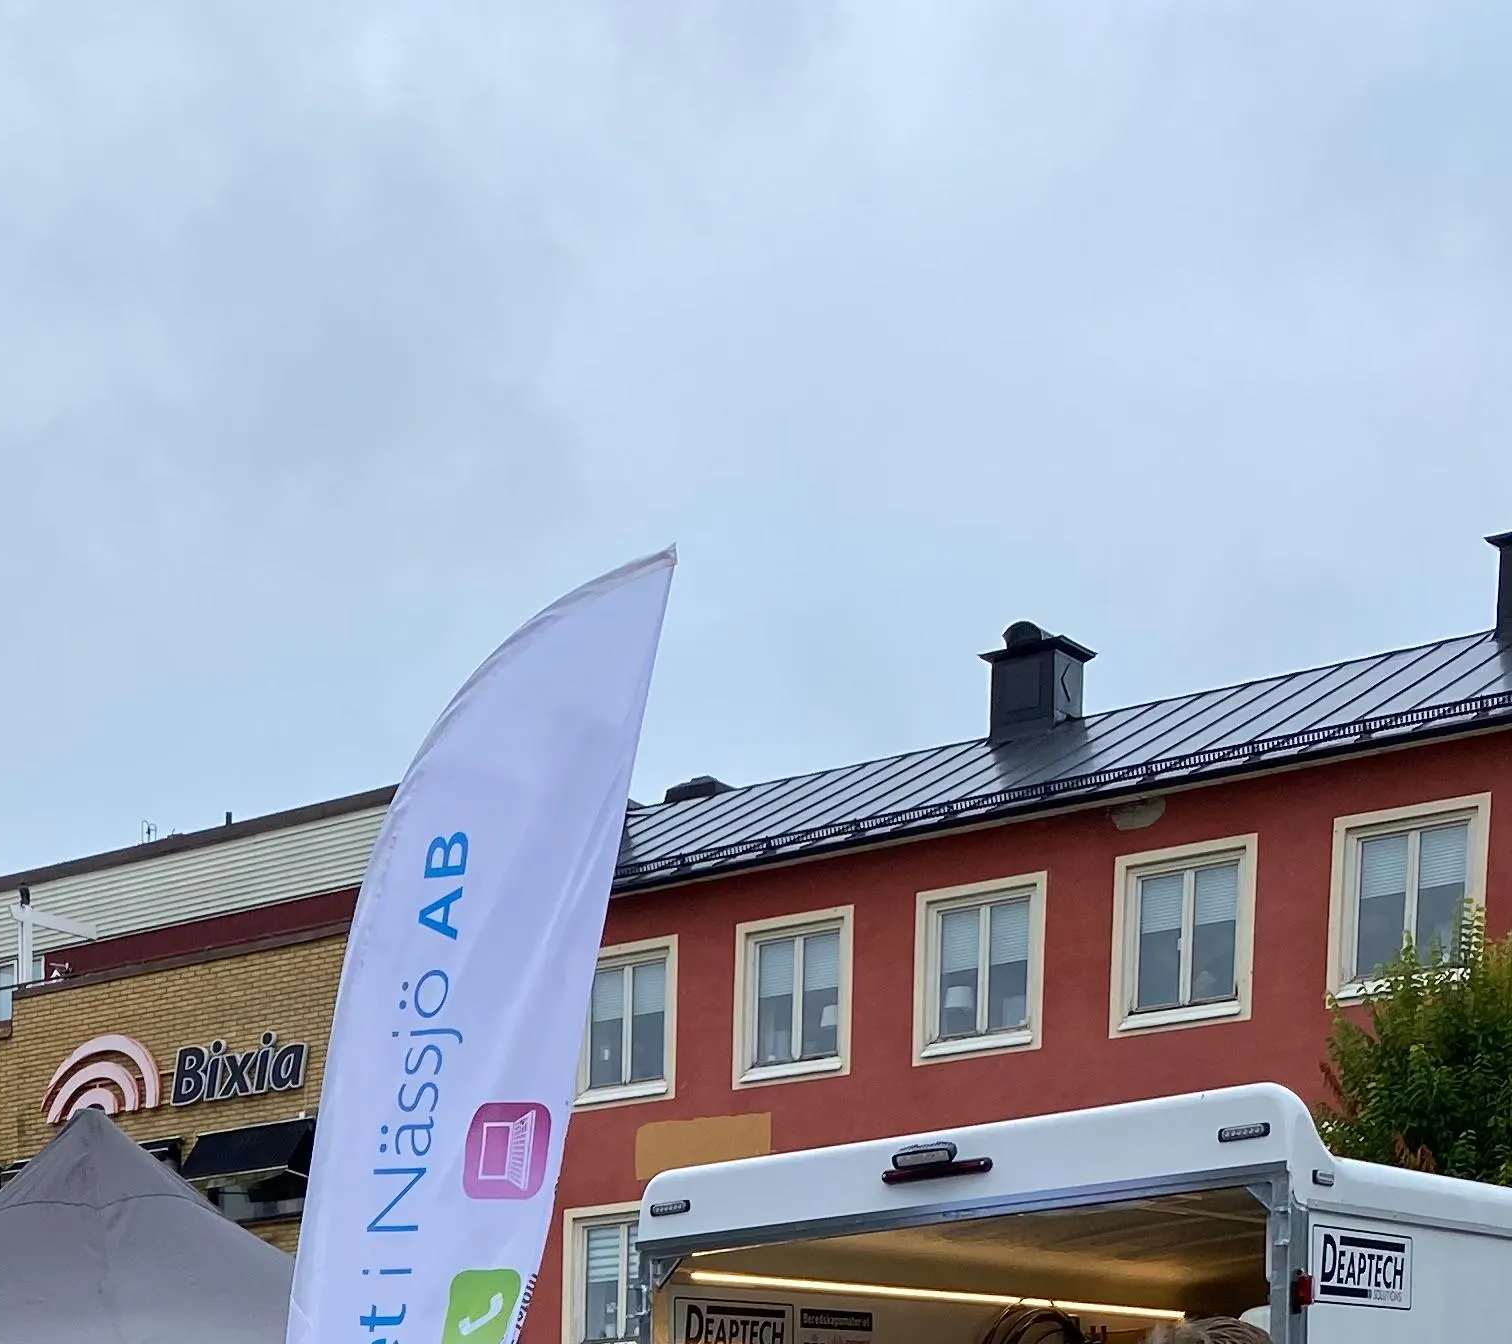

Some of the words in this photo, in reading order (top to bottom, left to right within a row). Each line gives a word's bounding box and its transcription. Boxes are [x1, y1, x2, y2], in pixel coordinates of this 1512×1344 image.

[418, 831, 469, 941] AB
[171, 1030, 307, 1106] Bixia
[366, 969, 463, 1233] Nässjö
[361, 1267, 412, 1276] i
[1321, 1234, 1405, 1290] DEAPTECH
